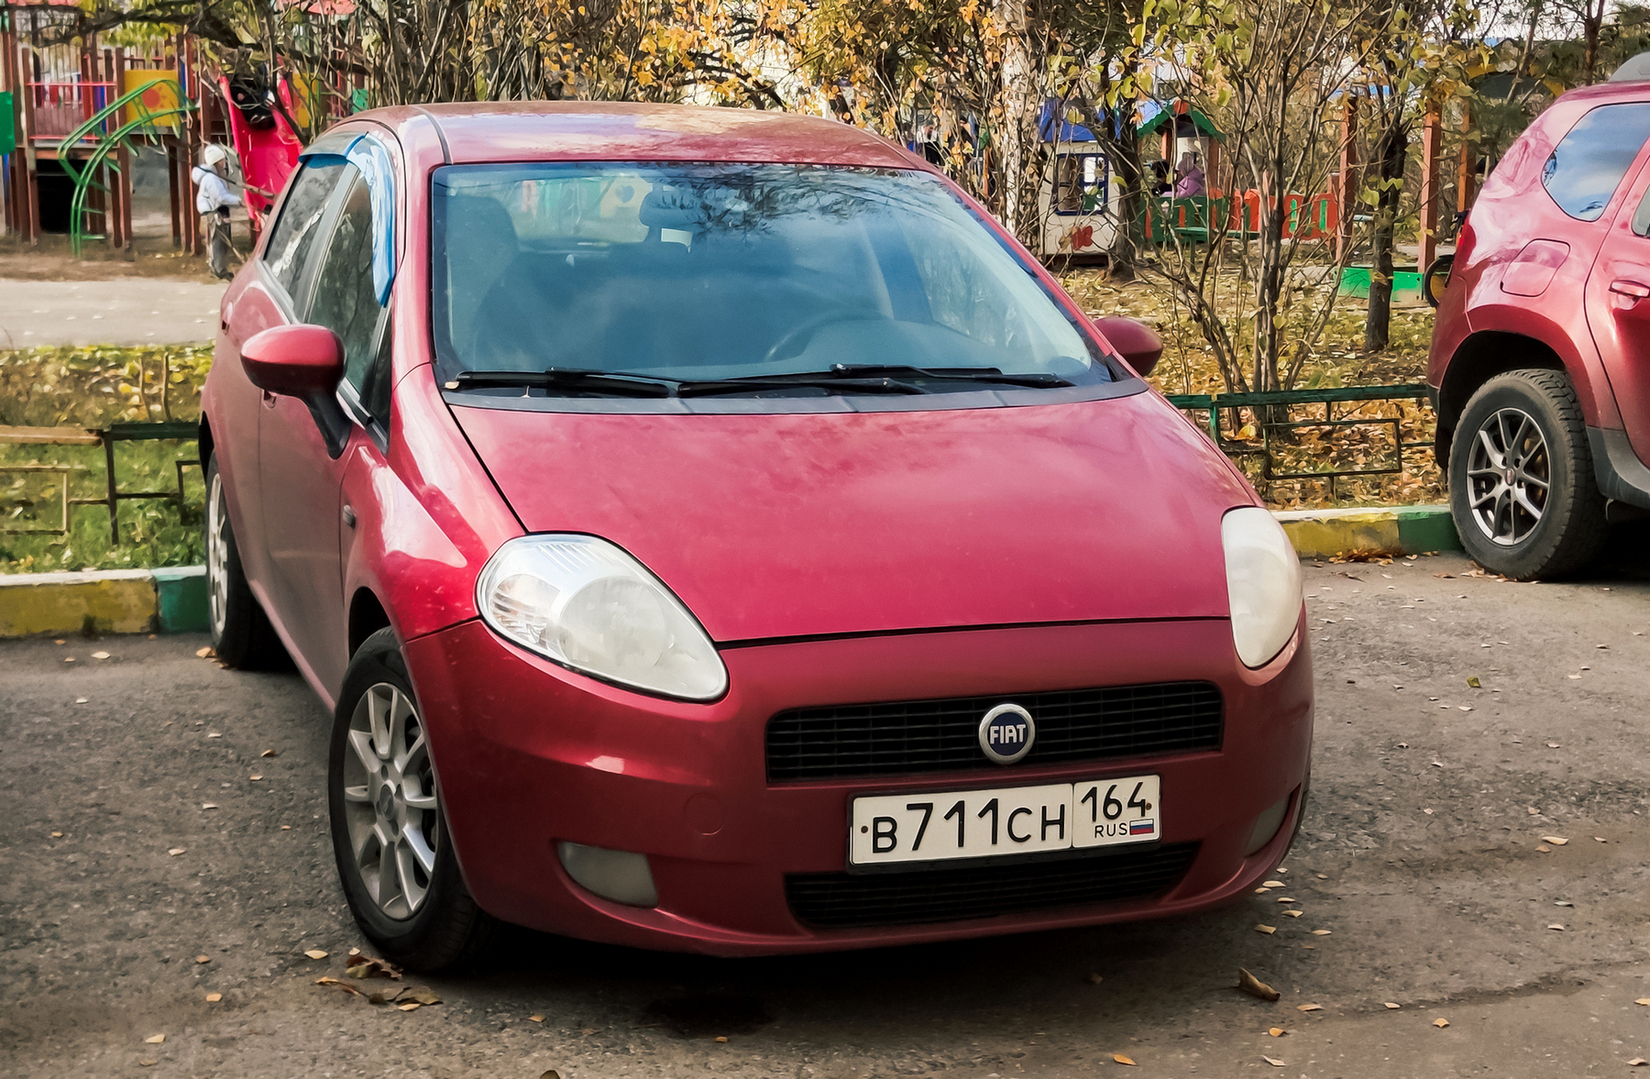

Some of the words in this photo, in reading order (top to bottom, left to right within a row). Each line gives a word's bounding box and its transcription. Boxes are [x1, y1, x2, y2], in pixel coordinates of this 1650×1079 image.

[989, 723, 1026, 745] FIAT
[1080, 781, 1147, 823] 164
[1094, 822, 1128, 838] RUS
